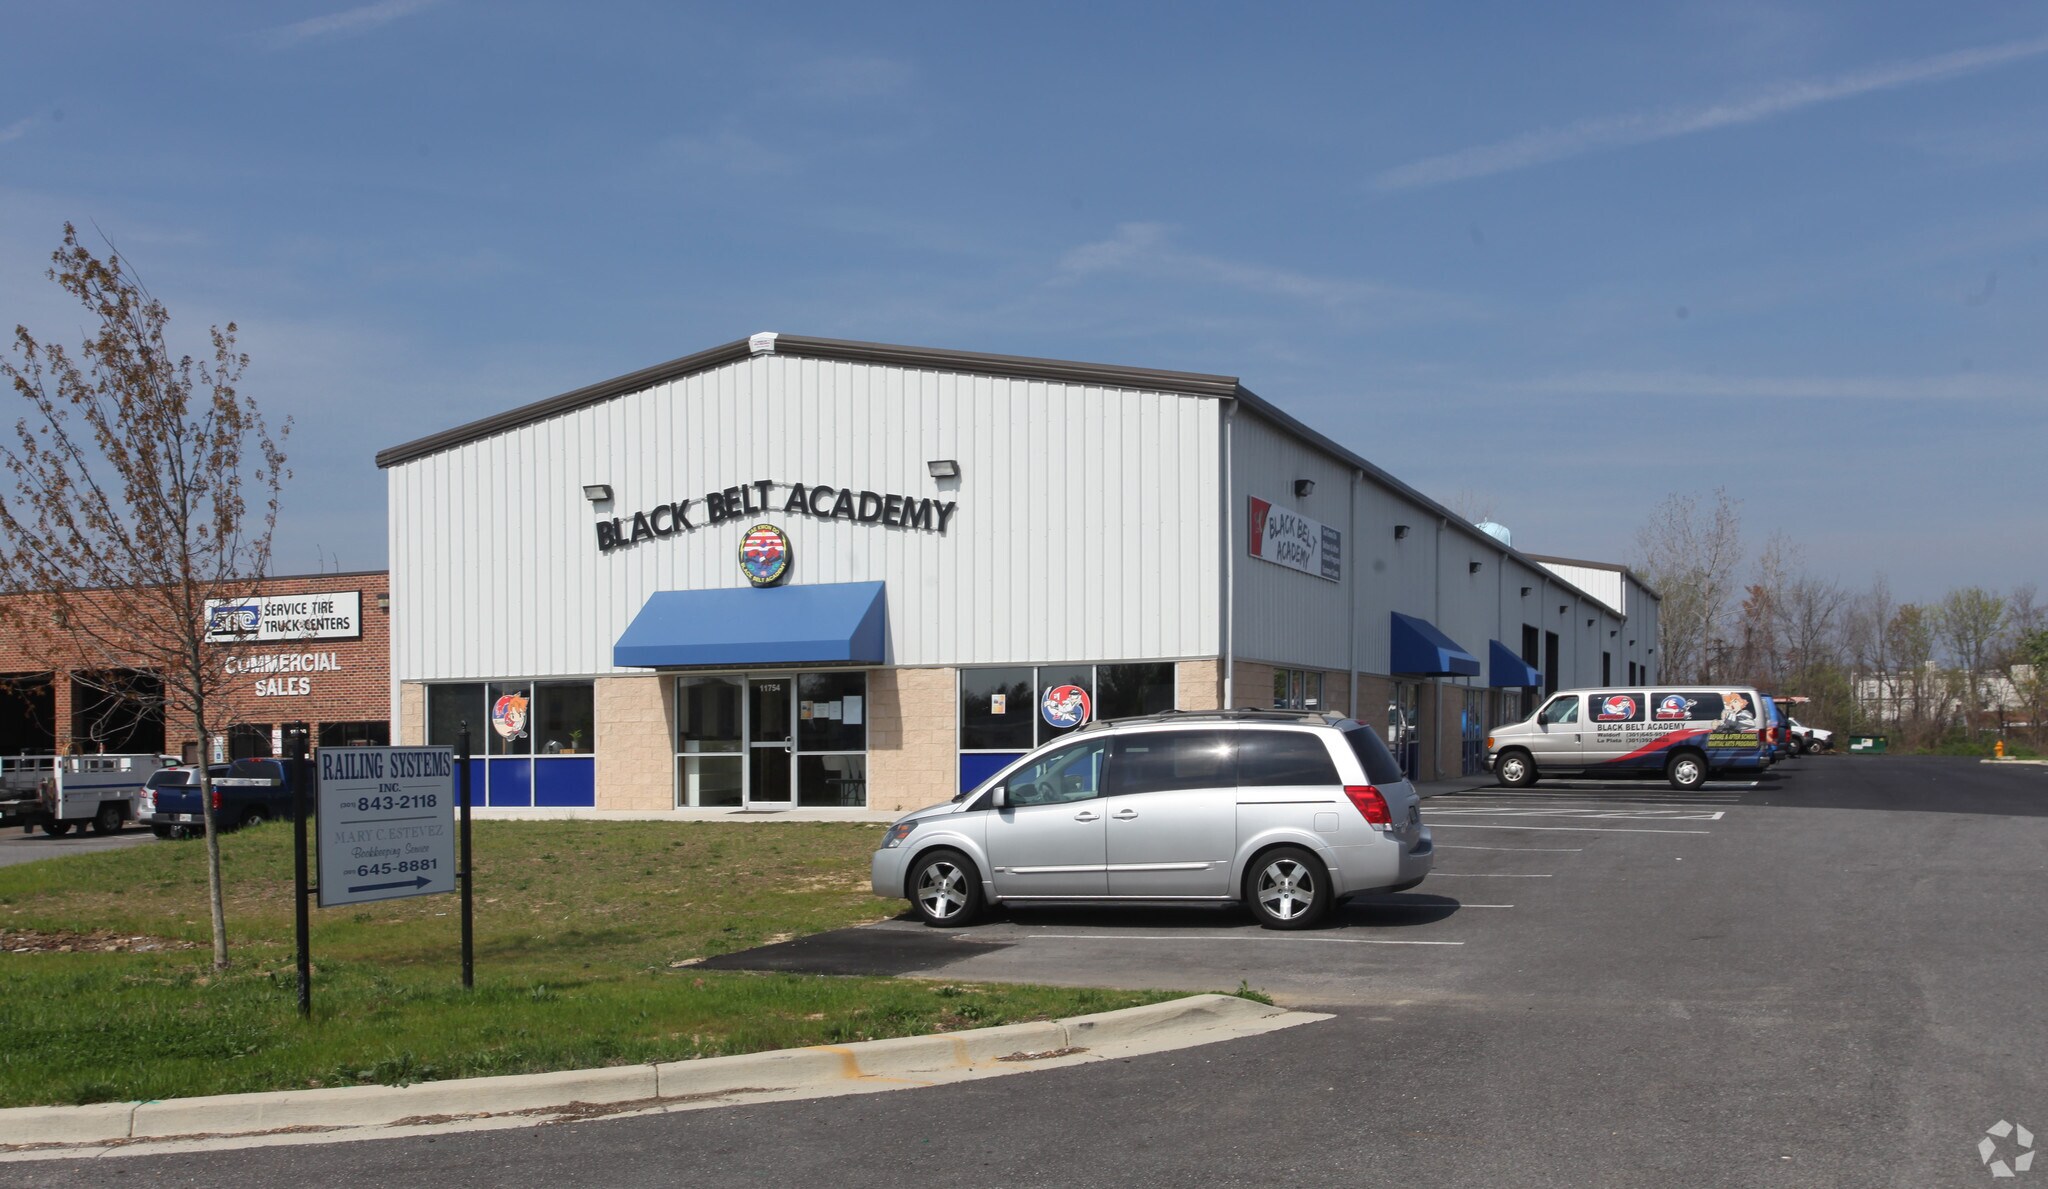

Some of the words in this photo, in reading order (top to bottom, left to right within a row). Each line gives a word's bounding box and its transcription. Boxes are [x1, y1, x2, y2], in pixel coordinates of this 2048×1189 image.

[596, 499, 693, 551] BLACK
[706, 480, 773, 523] BELT
[784, 482, 955, 532] ACADEMY
[1269, 513, 1296, 540] BLACK
[1297, 518, 1317, 556] BELT
[1276, 540, 1310, 570] ACADEMY
[265, 602, 307, 617] SERVICE
[312, 601, 334, 614] TIRE
[265, 619, 300, 633] TRUCK
[304, 617, 350, 632] CENTERS
[225, 652, 342, 674] COMMERCIAL
[256, 677, 310, 697] SALES
[760, 684, 781, 692] 11754
[1625, 723, 1645, 731] BELT
[1647, 722, 1686, 731] ACADEMY
[322, 752, 383, 780] RAILING
[390, 751, 451, 779] SYSTEMS
[379, 783, 402, 793] INC.
[358, 794, 437, 811] 843-2118
[335, 829, 374, 844] MARY
[389, 824, 444, 840] ESTEVEZ
[351, 846, 401, 859] Bookkeeping
[405, 843, 430, 855] Service
[358, 858, 437, 877] 645-8881
